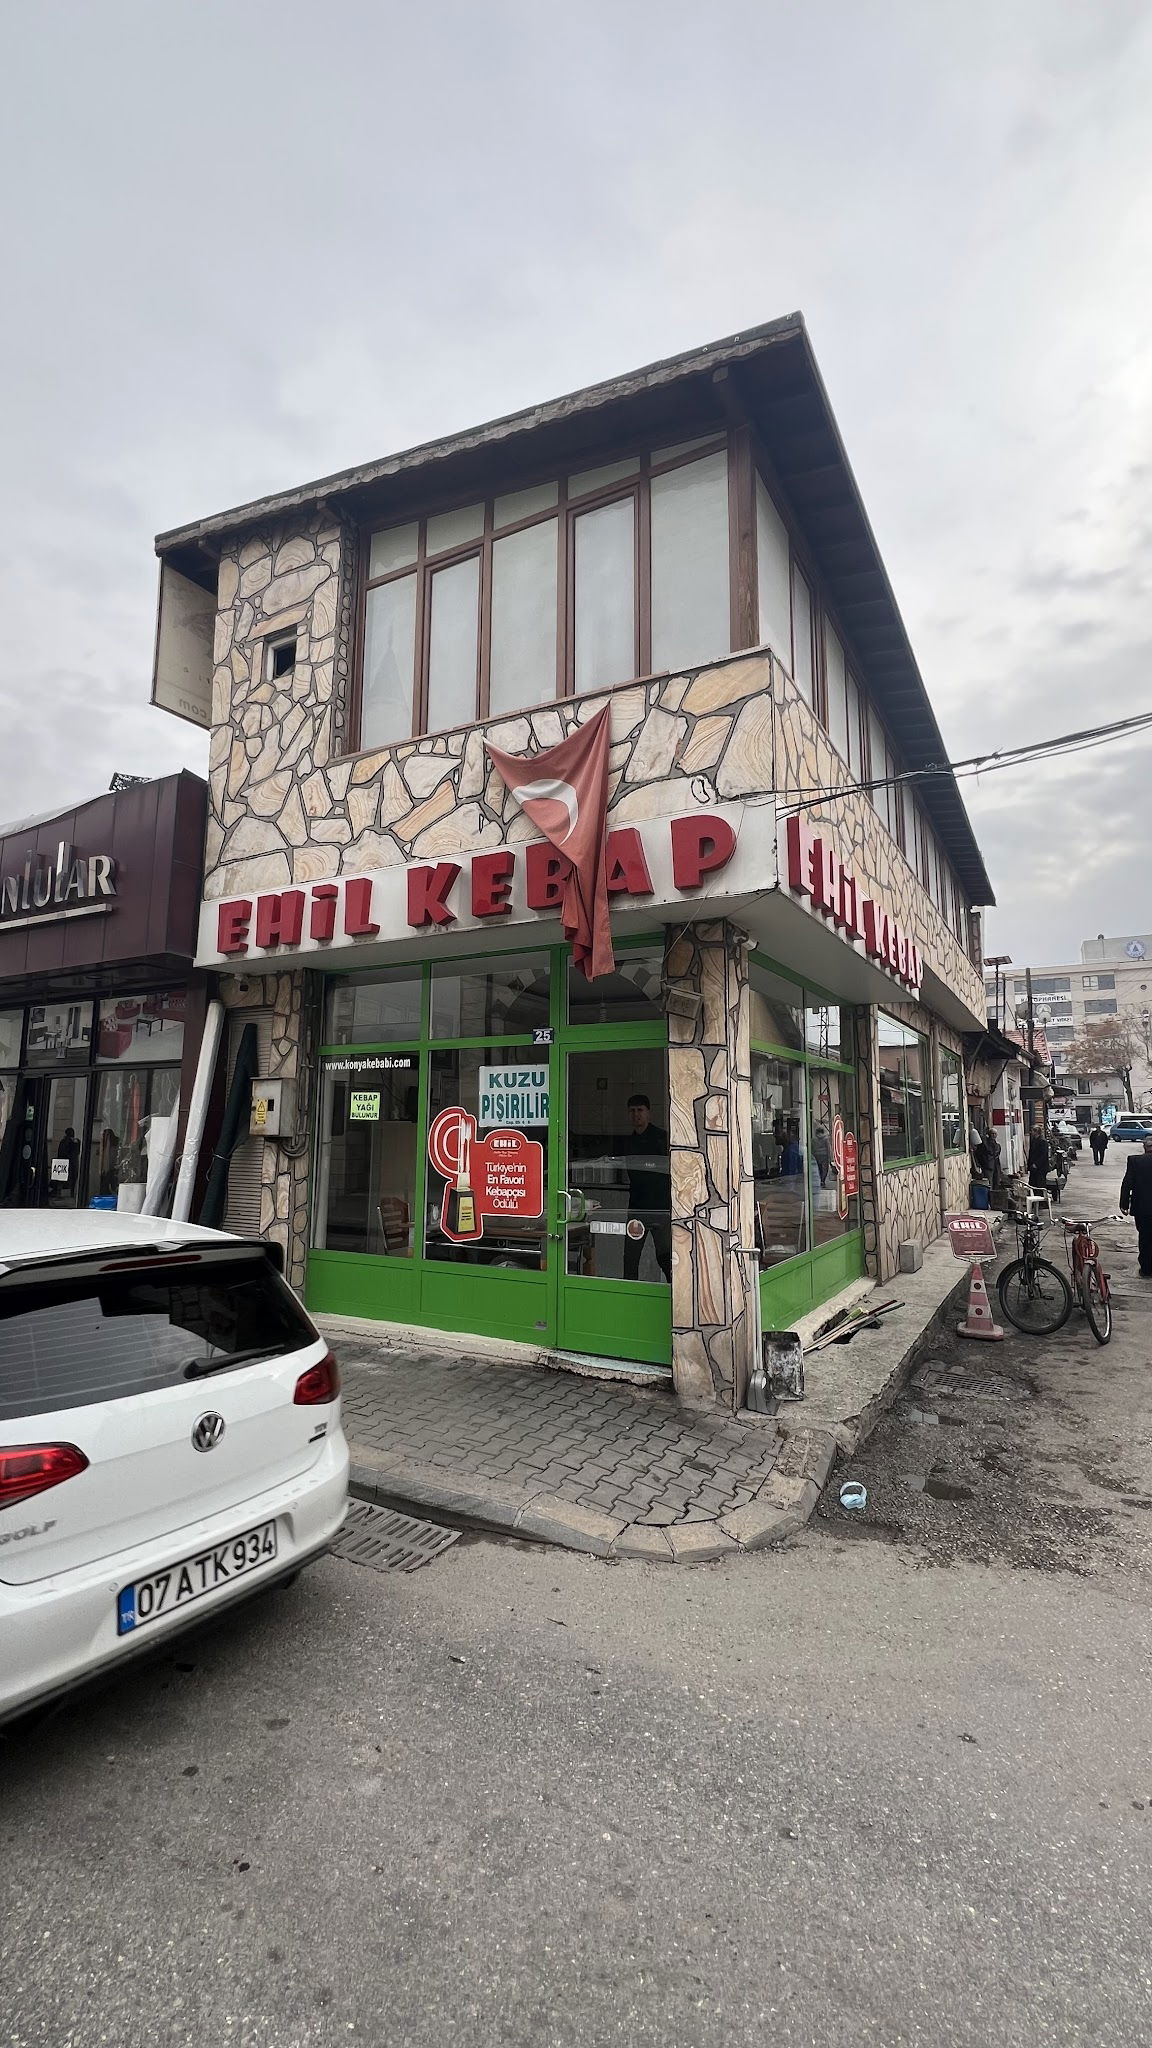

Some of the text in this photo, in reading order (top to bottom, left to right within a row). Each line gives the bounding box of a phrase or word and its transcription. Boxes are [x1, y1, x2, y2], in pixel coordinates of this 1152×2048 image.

[217, 813, 738, 954] EHİL KEBAP
[787, 816, 924, 991] EHİL KEBAP
[535, 1029, 552, 1042] 25
[325, 1056, 411, 1072] www.konyakebabi.com
[488, 1071, 546, 1089] KUZU
[352, 1094, 378, 1102] KEBAP
[356, 1102, 375, 1111] YAĞI
[52, 1163, 68, 1176] AÇIK
[485, 1161, 527, 1175] Türkiye'nin
[487, 1174, 525, 1185] En Favori
[485, 1186, 526, 1199] Kebapçısı
[492, 1196, 519, 1209] Ödülü
[0, 1518, 58, 1546] GOLF
